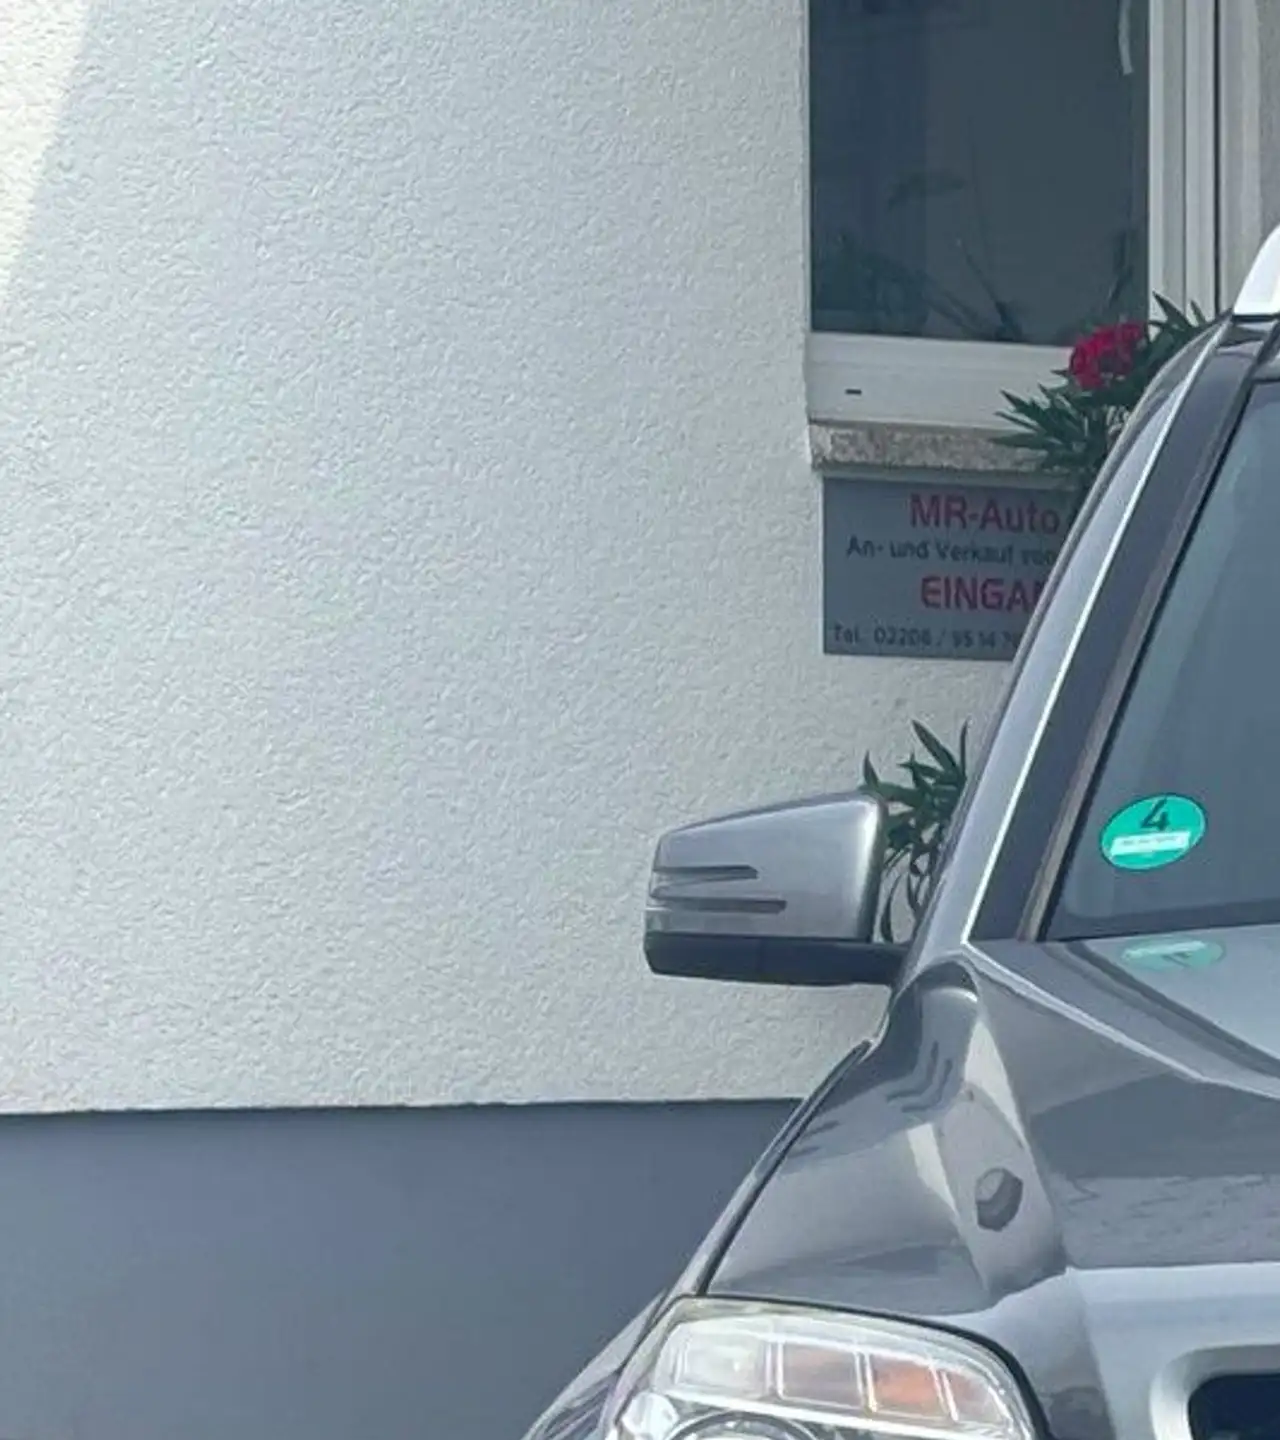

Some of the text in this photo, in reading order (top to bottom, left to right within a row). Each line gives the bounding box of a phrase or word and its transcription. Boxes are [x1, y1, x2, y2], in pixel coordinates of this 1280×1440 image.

[890, 538, 930, 561] und
[935, 540, 1014, 567] Verkauf
[1140, 797, 1169, 831] 4
